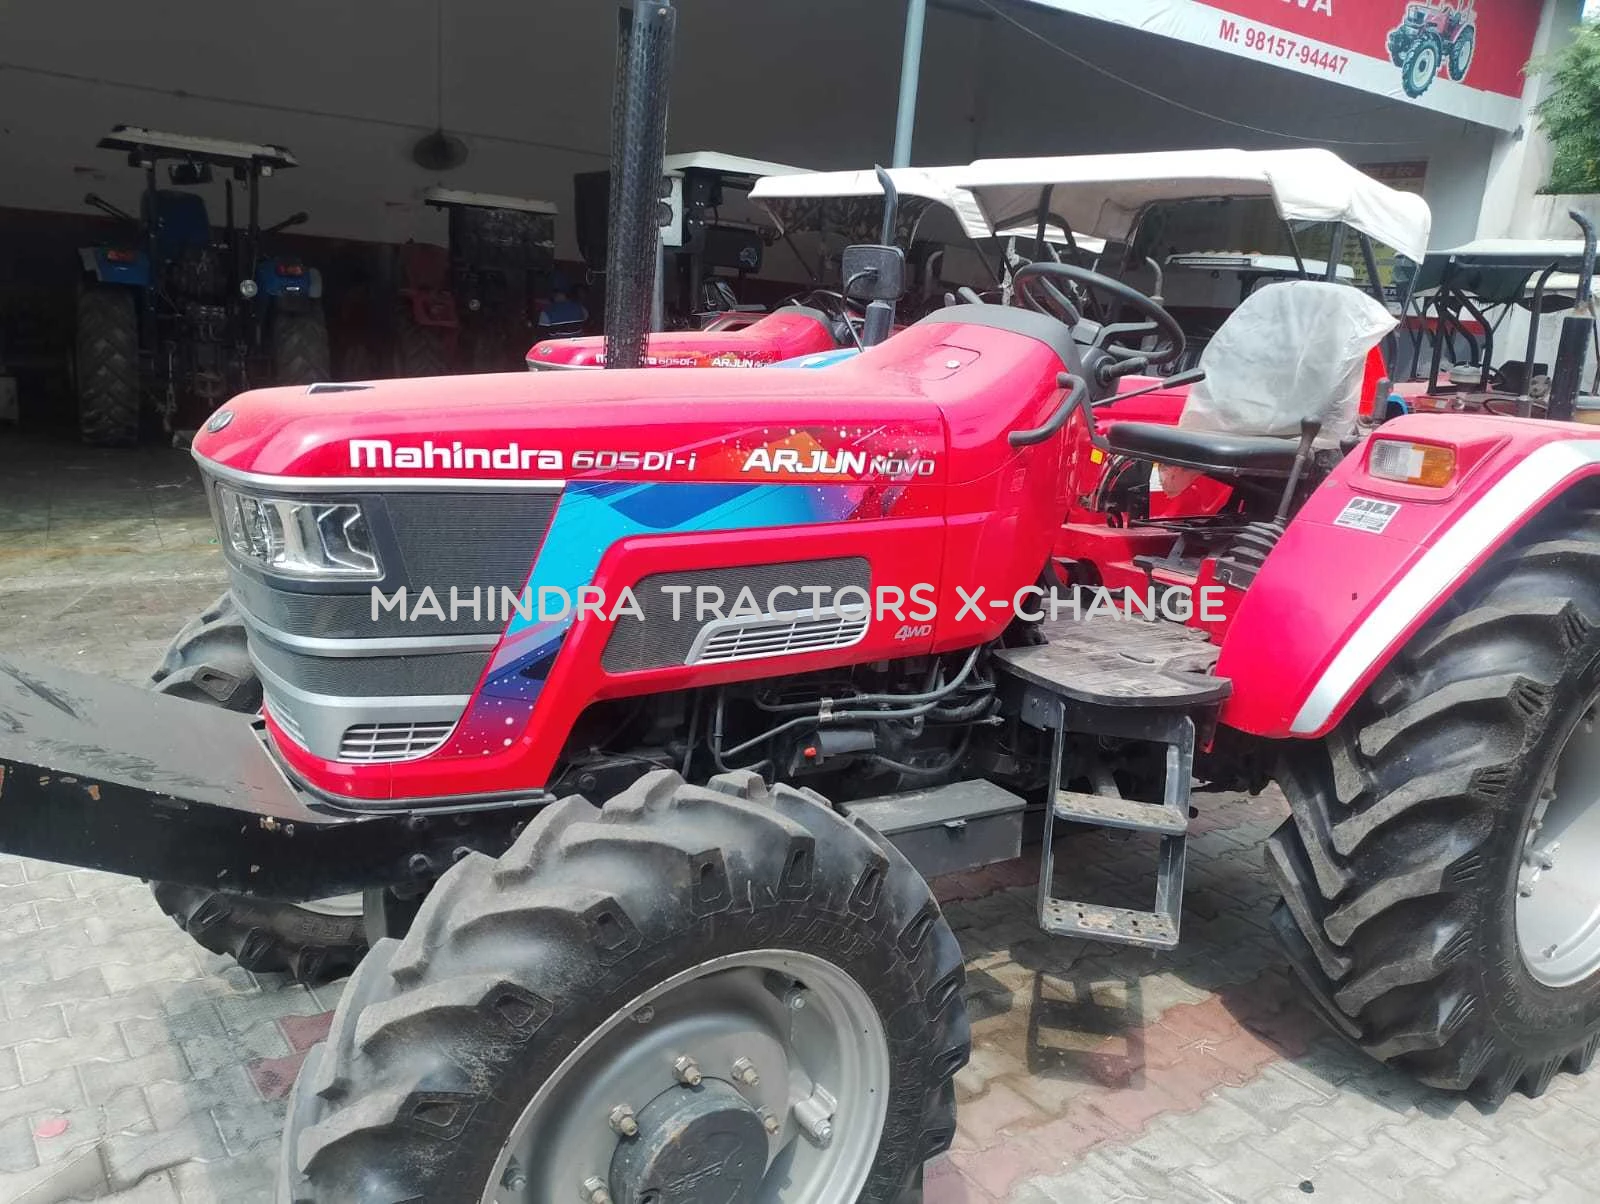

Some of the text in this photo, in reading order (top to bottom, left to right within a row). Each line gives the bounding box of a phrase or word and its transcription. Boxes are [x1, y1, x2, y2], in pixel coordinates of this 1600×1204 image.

[1219, 19, 1349, 75] M: 98157-94447
[711, 358, 754, 368] ARJUN
[349, 439, 935, 476] Mahindra 605DI-i ARJUN NOVO
[894, 624, 932, 641] 4WD
